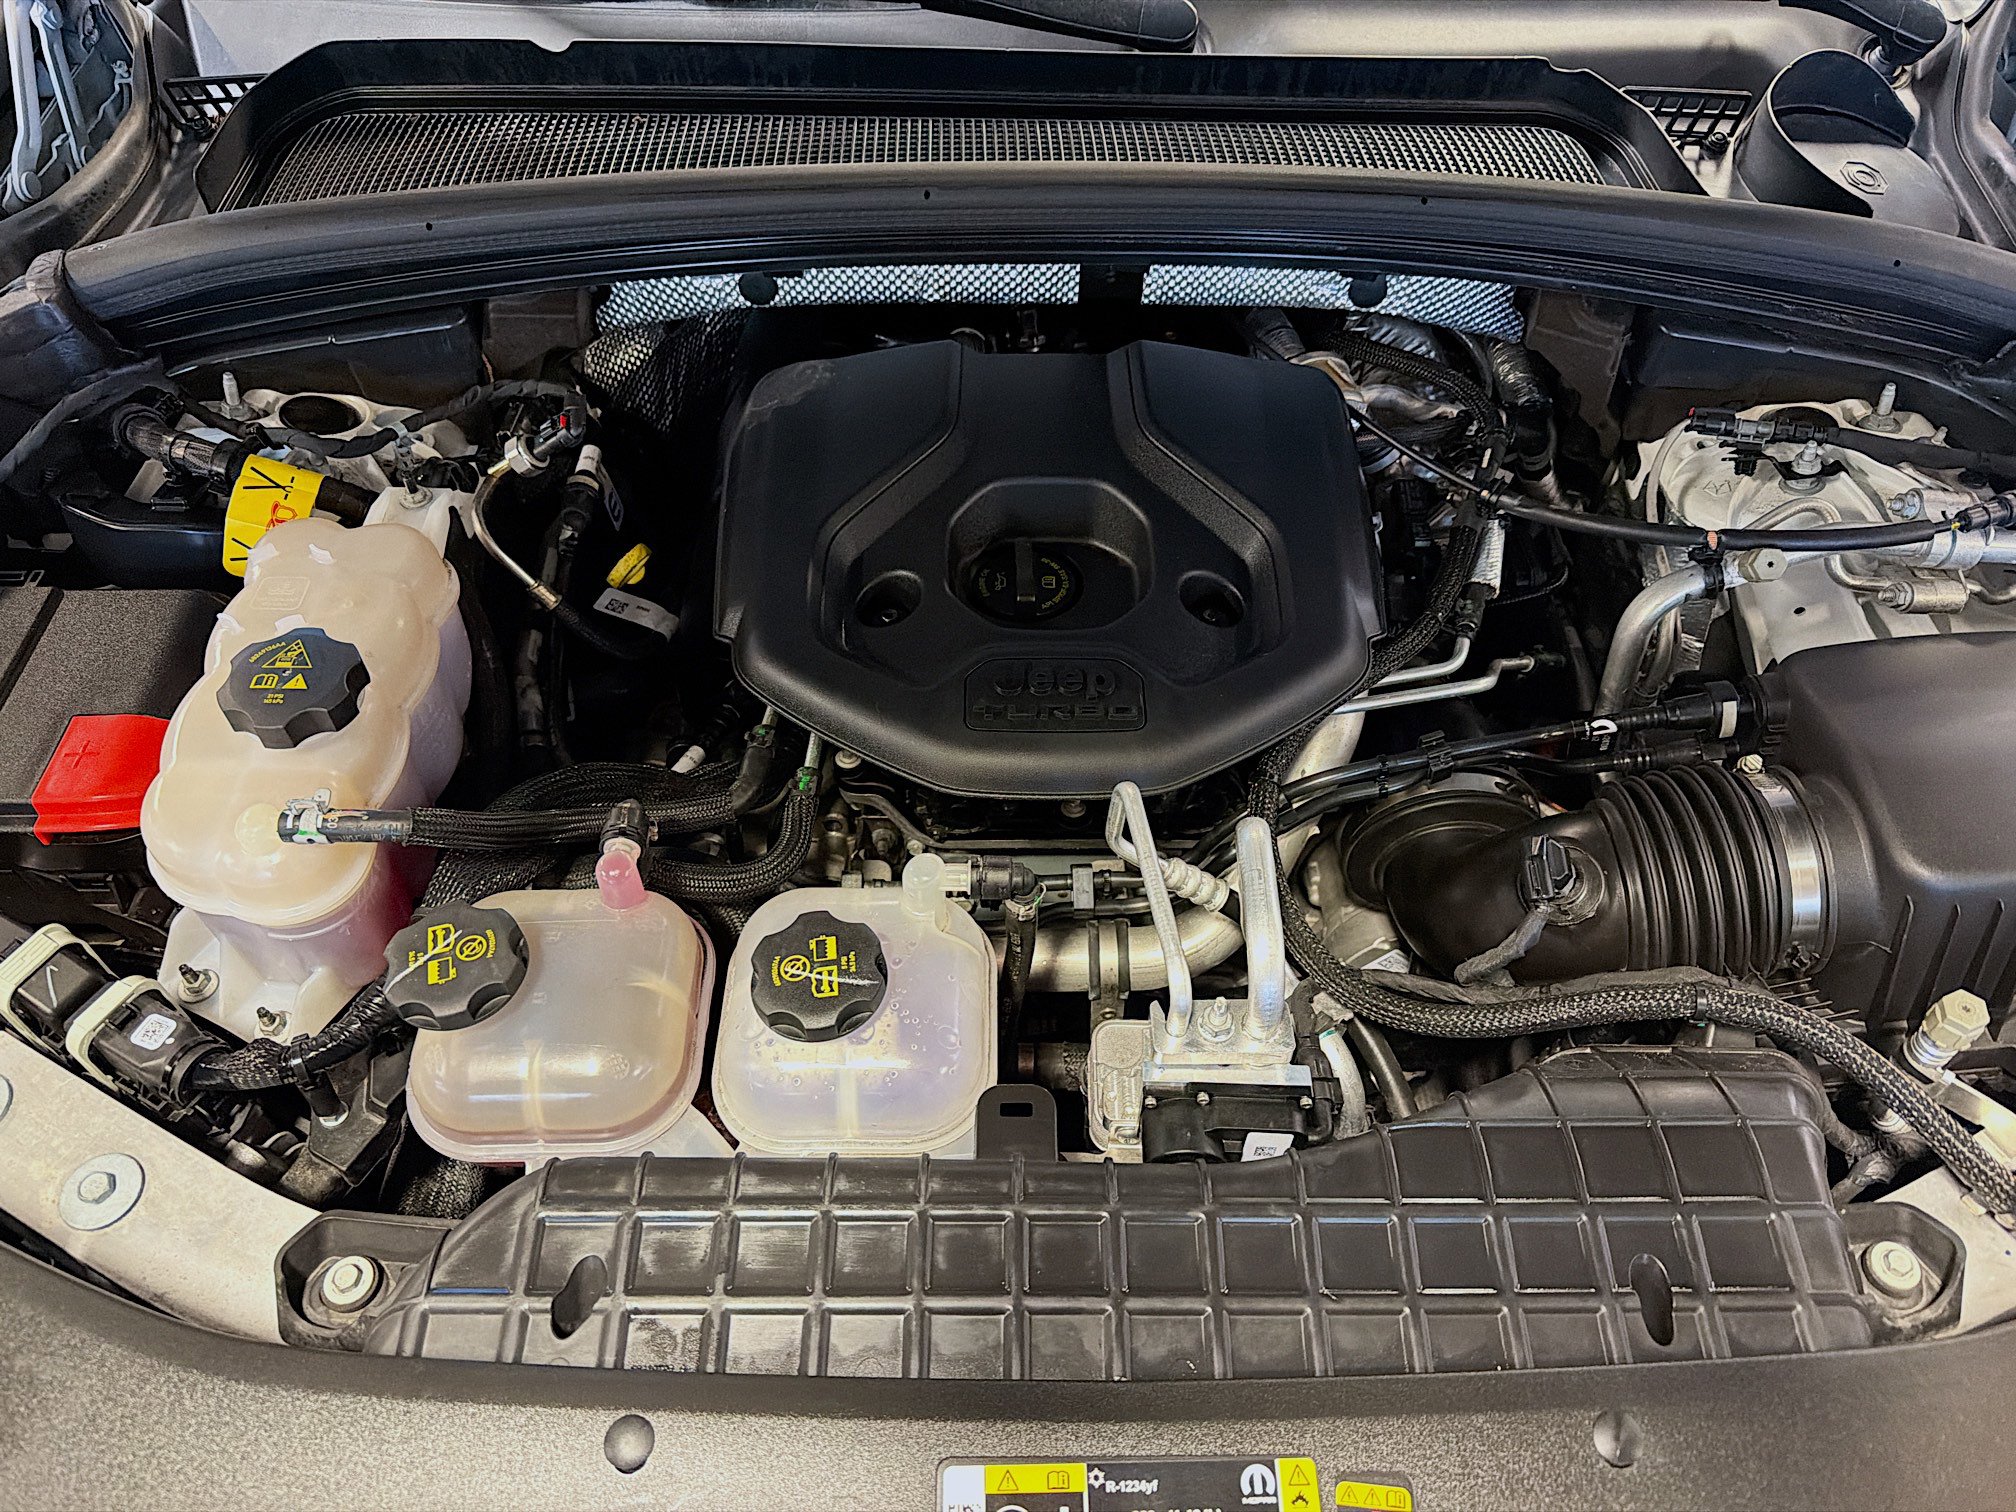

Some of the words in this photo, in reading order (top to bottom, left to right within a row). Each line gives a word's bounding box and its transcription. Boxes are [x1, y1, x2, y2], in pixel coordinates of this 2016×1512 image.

[994, 662, 1116, 701] Jeep
[973, 704, 1138, 721] TURBO
[1105, 1479, 1159, 1495] R-1234yf
